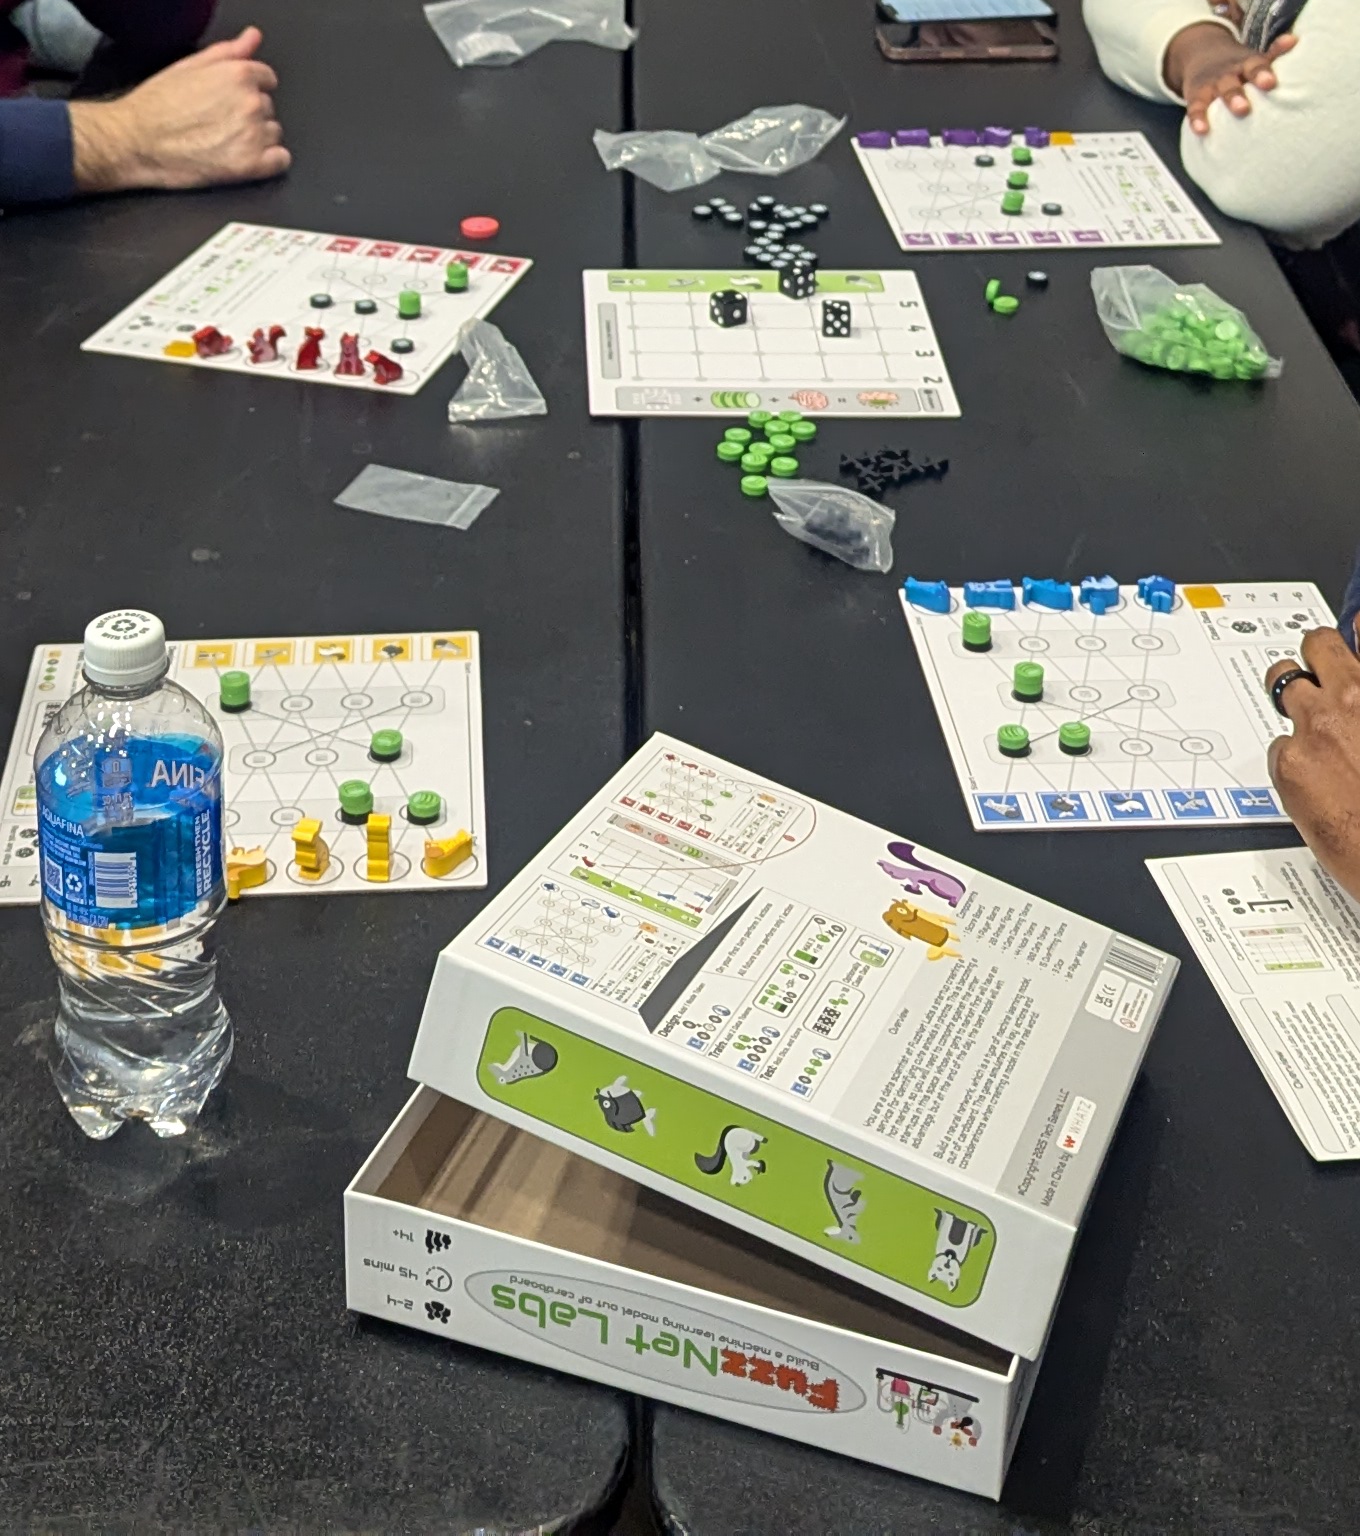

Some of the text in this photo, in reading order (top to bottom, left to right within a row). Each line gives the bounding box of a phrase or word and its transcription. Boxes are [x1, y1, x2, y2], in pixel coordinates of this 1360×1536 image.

[899, 300, 919, 308] 5
[907, 324, 926, 333] 4
[923, 376, 943, 384] 2
[201, 808, 213, 893] RECYCLE
[990, 965, 999, 974] an
[967, 975, 981, 992] other
[981, 972, 995, 987] have
[960, 990, 972, 1004] the
[978, 984, 991, 996] will
[989, 988, 999, 999] will
[969, 994, 983, 1008] first
[980, 997, 994, 1015] model
[1005, 992, 1025, 1015] learning
[1023, 995, 1034, 1009] and
[951, 1000, 966, 1022] against
[960, 1007, 975, 1028] market
[1014, 1007, 1032, 1028] actions
[657, 1014, 681, 1037] Design:
[887, 1007, 909, 1035] Overview
[973, 1013, 985, 1028] best
[995, 1014, 1012, 1037] machine
[937, 1021, 955, 1046] compete
[955, 1027, 966, 1035] to
[967, 1027, 979, 1038] the
[1005, 1028, 1021, 1040] key
[1020, 1027, 1032, 1040] real
[862, 962, 964, 1127] You are data scientist at FuzzNet Labs startup creating
[876, 1108, 894, 1133] service
[886, 1096, 900, 1110] for
[895, 1064, 922, 1097] identifying
[913, 1049, 926, 1065] cute
[921, 1028, 938, 1051] animals
[932, 1022, 942, 1030] in
[945, 990, 960, 1002] This
[956, 961, 978, 986] becoming
[949, 1034, 962, 1050] gets
[961, 1038, 976, 1051] day
[991, 1034, 1000, 1045] of
[1000, 1039, 1016, 1051] the
[1014, 1039, 1026, 1050] the
[707, 1040, 728, 1058] Train:
[932, 1045, 943, 1053] to
[955, 1048, 968, 1061] the
[983, 1043, 997, 1058] type
[1012, 1049, 1021, 1057] in
[925, 1052, 939, 1069] need
[934, 1048, 953, 1075] Whoever
[951, 1058, 961, 1069] of
[979, 1062, 988, 1070] is
[989, 1050, 1008, 1078] simulates
[1004, 1055, 1018, 1074] model
[759, 1064, 777, 1080] Test:
[919, 1067, 930, 1080] will
[946, 1067, 958, 1081] end
[970, 1068, 984, 1087] which
[913, 1077, 925, 1093] you
[938, 1080, 951, 1092] the
[980, 1077, 994, 1095] game
[989, 1078, 1010, 1105] creating
[907, 1091, 918, 1101] so
[917, 1093, 931, 1107] this
[936, 1091, 945, 1101] at
[971, 1093, 986, 1107] This
[1056, 1087, 1070, 1103] LLC
[912, 1106, 924, 1115] in
[927, 1099, 940, 1113] but
[981, 1103, 995, 1122] when
[1047, 1102, 1064, 1124] Games,
[946, 1113, 962, 1136] neural
[1068, 1099, 1091, 1134] WHATZ
[884, 1124, 899, 1138] hot
[899, 1113, 920, 1144] startups
[1039, 1123, 1054, 1139] Tech
[932, 1139, 949, 1159] Build
[952, 1140, 962, 1152] of
[958, 1121, 986, 1169] considerations
[1031, 1138, 1048, 1159] 2025
[946, 1150, 958, 1165] out
[1040, 1150, 1073, 1206] Made in China by
[392, 1228, 414, 1242] 14+
[362, 1257, 418, 1280] 45 mins
[508, 1274, 574, 1298] cardboard
[386, 1293, 413, 1310] 2-4
[577, 1294, 593, 1304] of
[595, 1299, 618, 1311] out
[621, 1306, 659, 1323] model
[661, 1316, 715, 1341] learning
[491, 1284, 838, 1411] FuzzNet Labs
[718, 1335, 771, 1355] machine
[785, 1354, 819, 1371] Build
